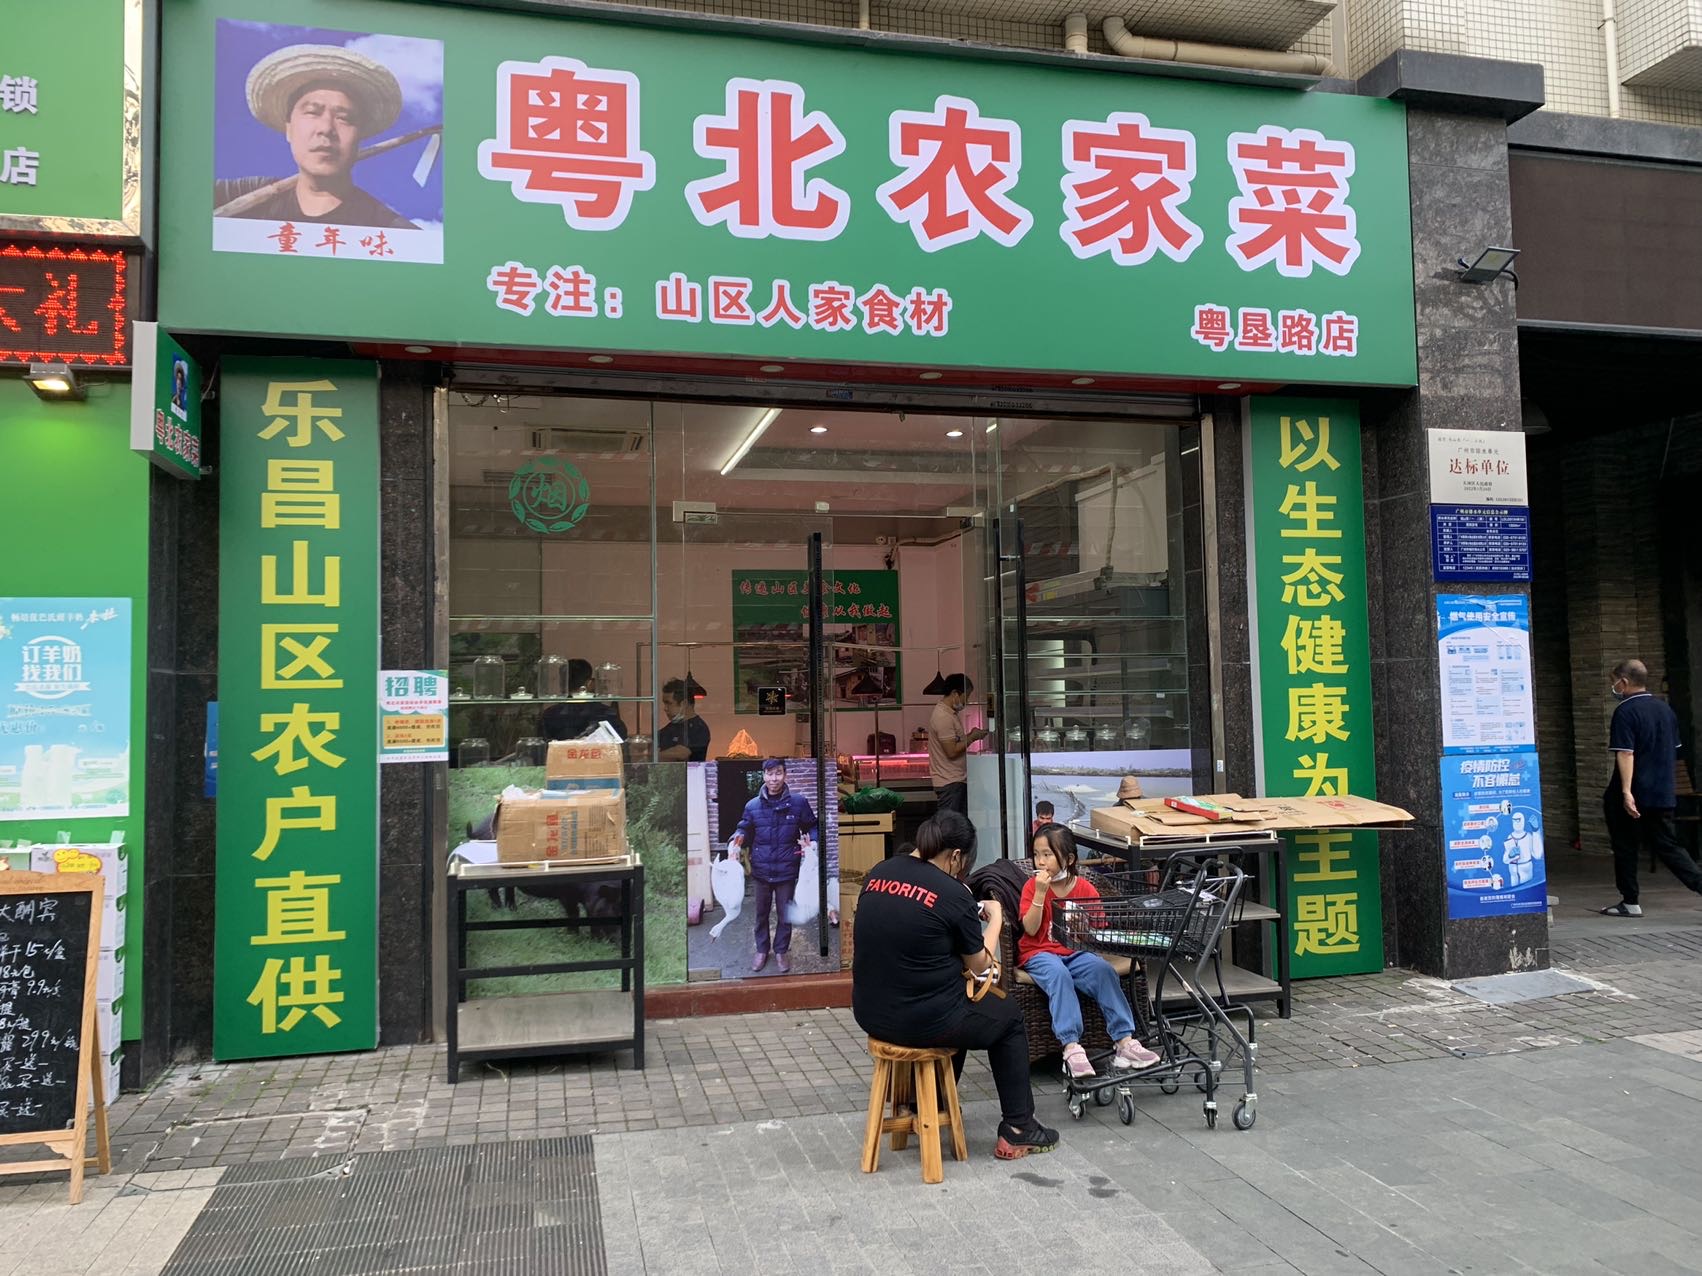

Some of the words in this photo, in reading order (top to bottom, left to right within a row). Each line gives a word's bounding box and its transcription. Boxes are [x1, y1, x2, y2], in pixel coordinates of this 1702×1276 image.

[0, 146, 39, 186] 店
[480, 58, 1358, 275] 粤北农家菜
[268, 222, 394, 257] 童年味
[1192, 305, 1358, 355] 粤垦路店
[1450, 458, 1510, 475] 达标单位
[22, 645, 81, 663] 订羊奶
[22, 664, 82, 681] 找我们
[385, 676, 437, 697] 招聘
[247, 378, 347, 1034] 乐昌山区农户直供
[1460, 759, 1510, 774] 疫情防控
[865, 878, 938, 908] FAVORITE
